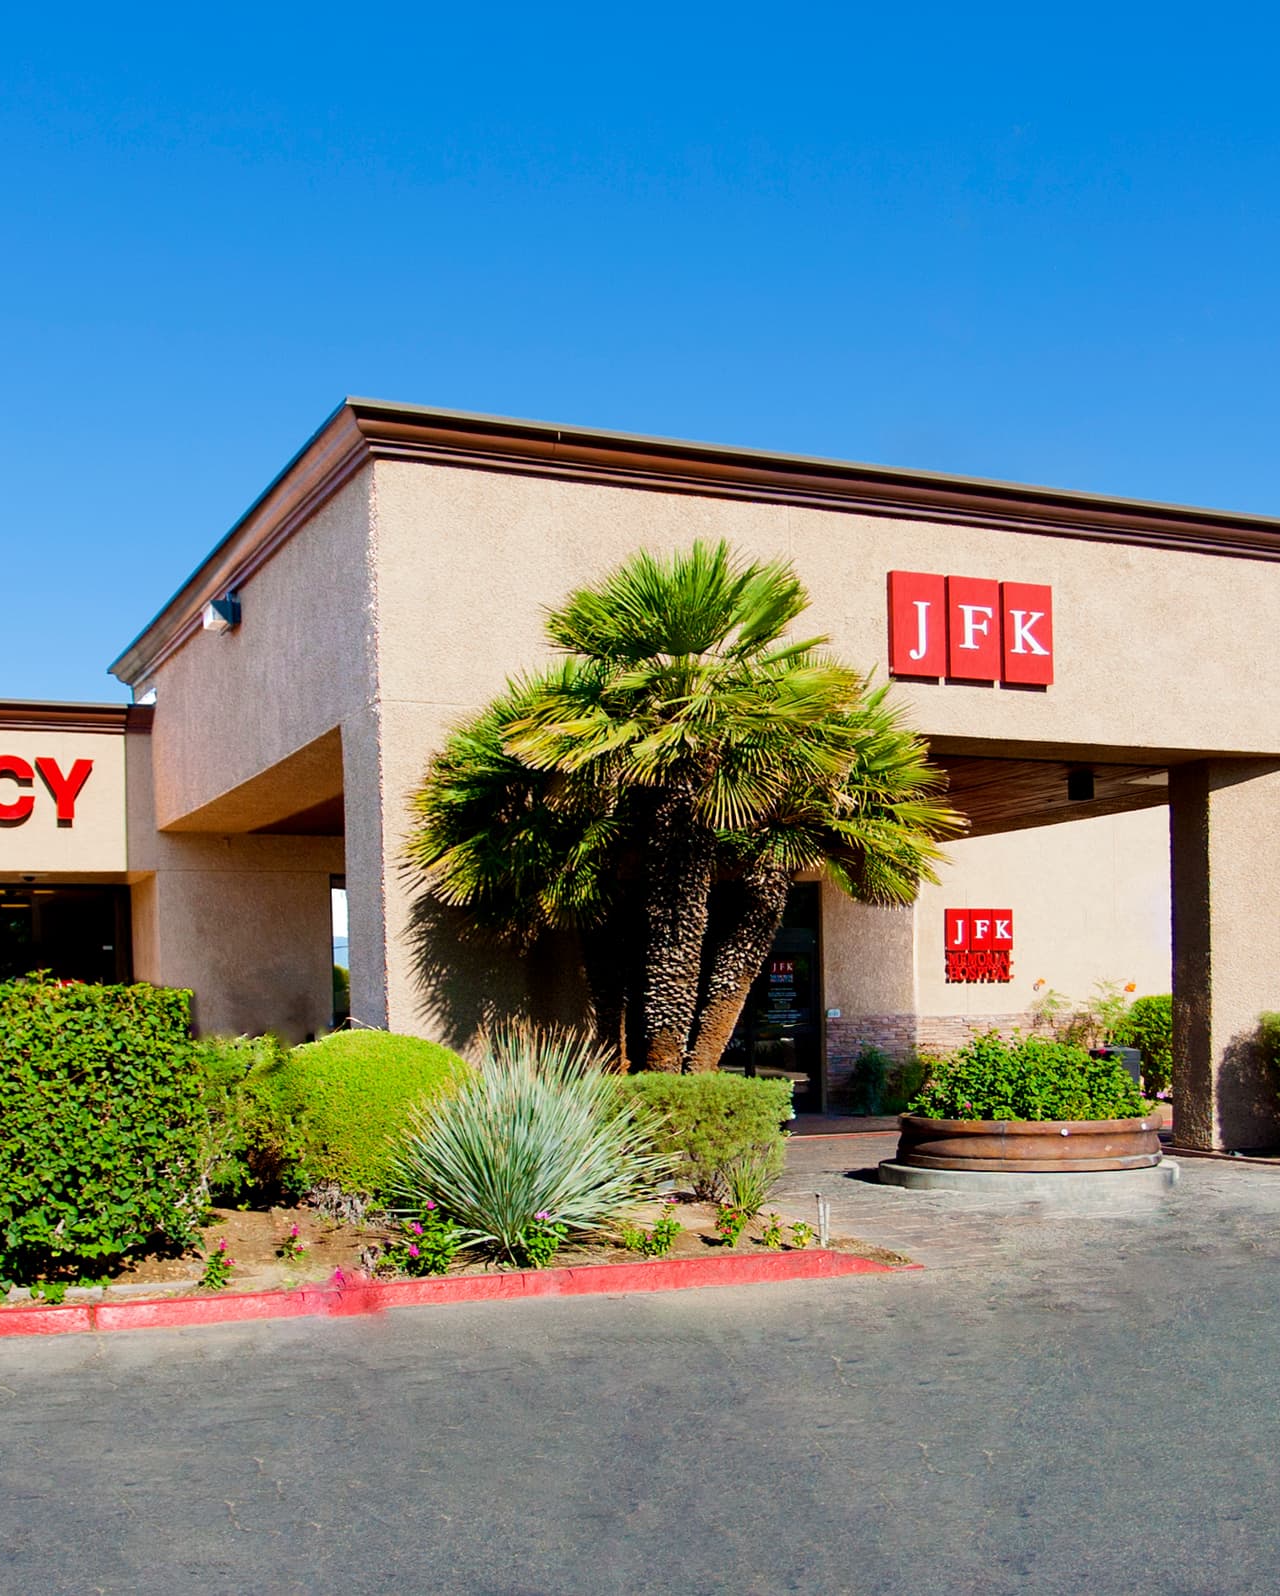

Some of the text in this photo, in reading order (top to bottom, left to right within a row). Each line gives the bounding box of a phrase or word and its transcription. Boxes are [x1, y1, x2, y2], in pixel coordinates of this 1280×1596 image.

[909, 600, 1050, 660] JFK
[954, 919, 1012, 945] JFK
[947, 966, 1013, 980] HOSPITAL
